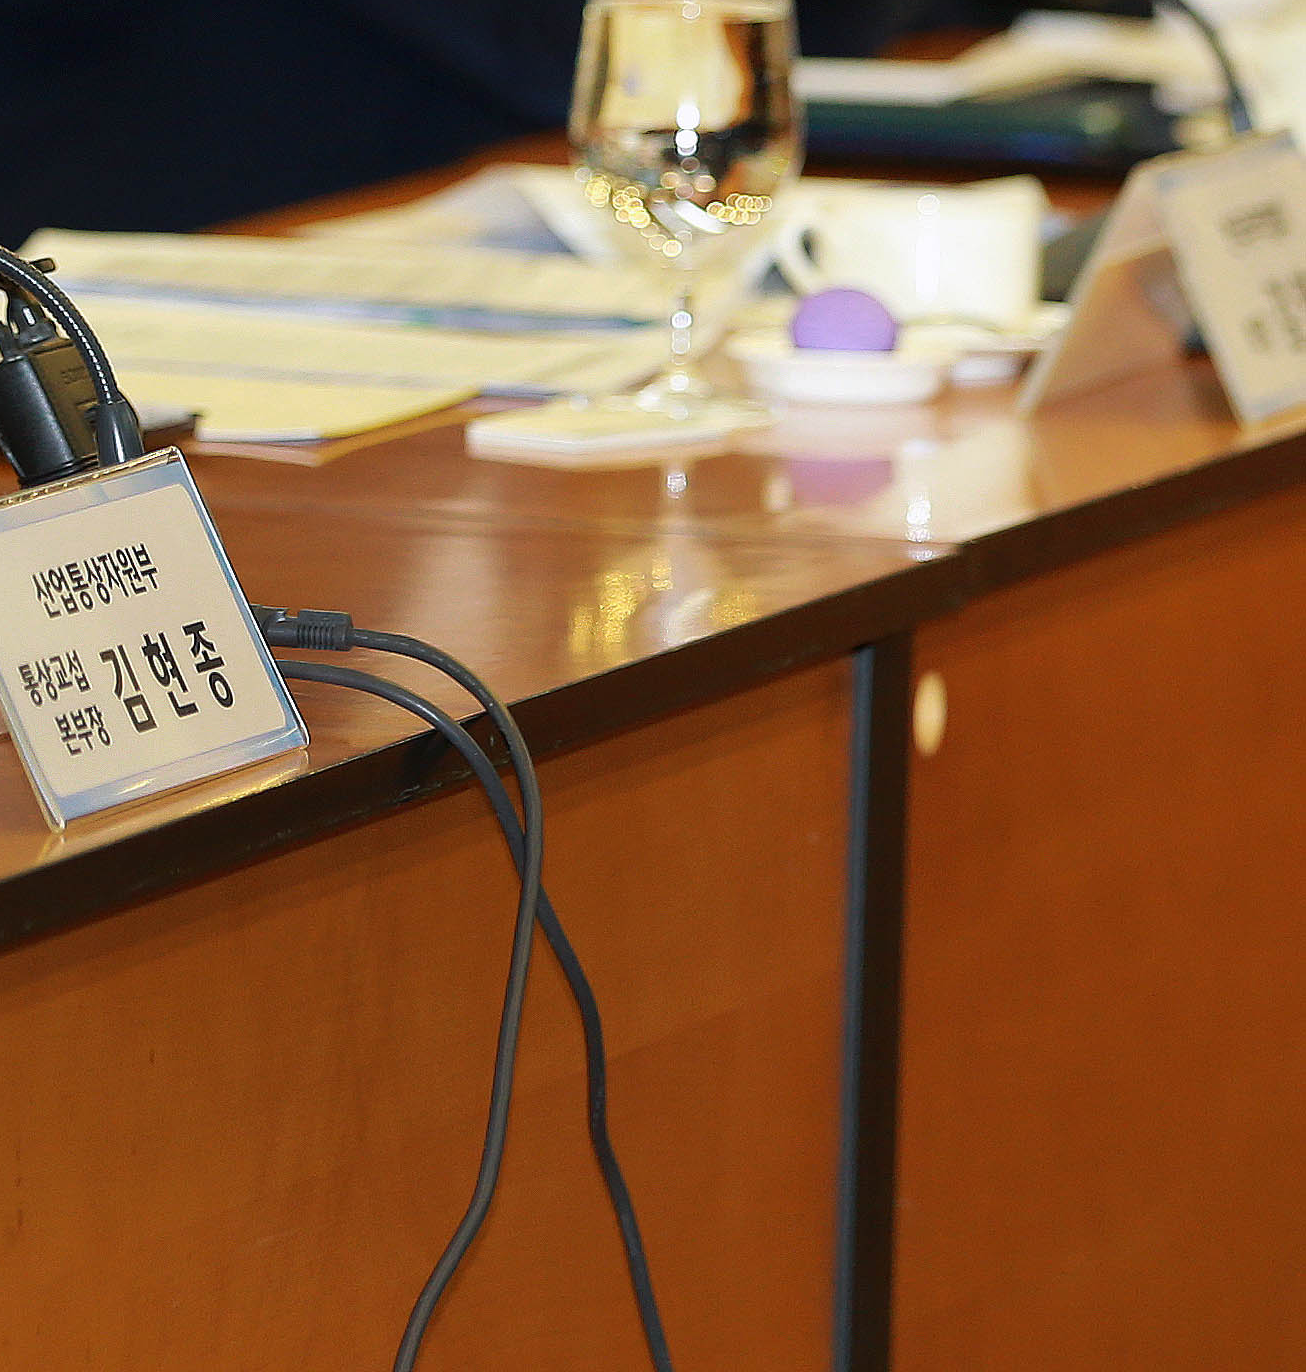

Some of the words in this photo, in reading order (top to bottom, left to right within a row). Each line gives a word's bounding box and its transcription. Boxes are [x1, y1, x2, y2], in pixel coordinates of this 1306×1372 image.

[31, 543, 158, 618] 산업통상자원부
[18, 650, 92, 706] 통상교섭
[100, 620, 235, 733] 김현종
[54, 705, 112, 756] 본부장
